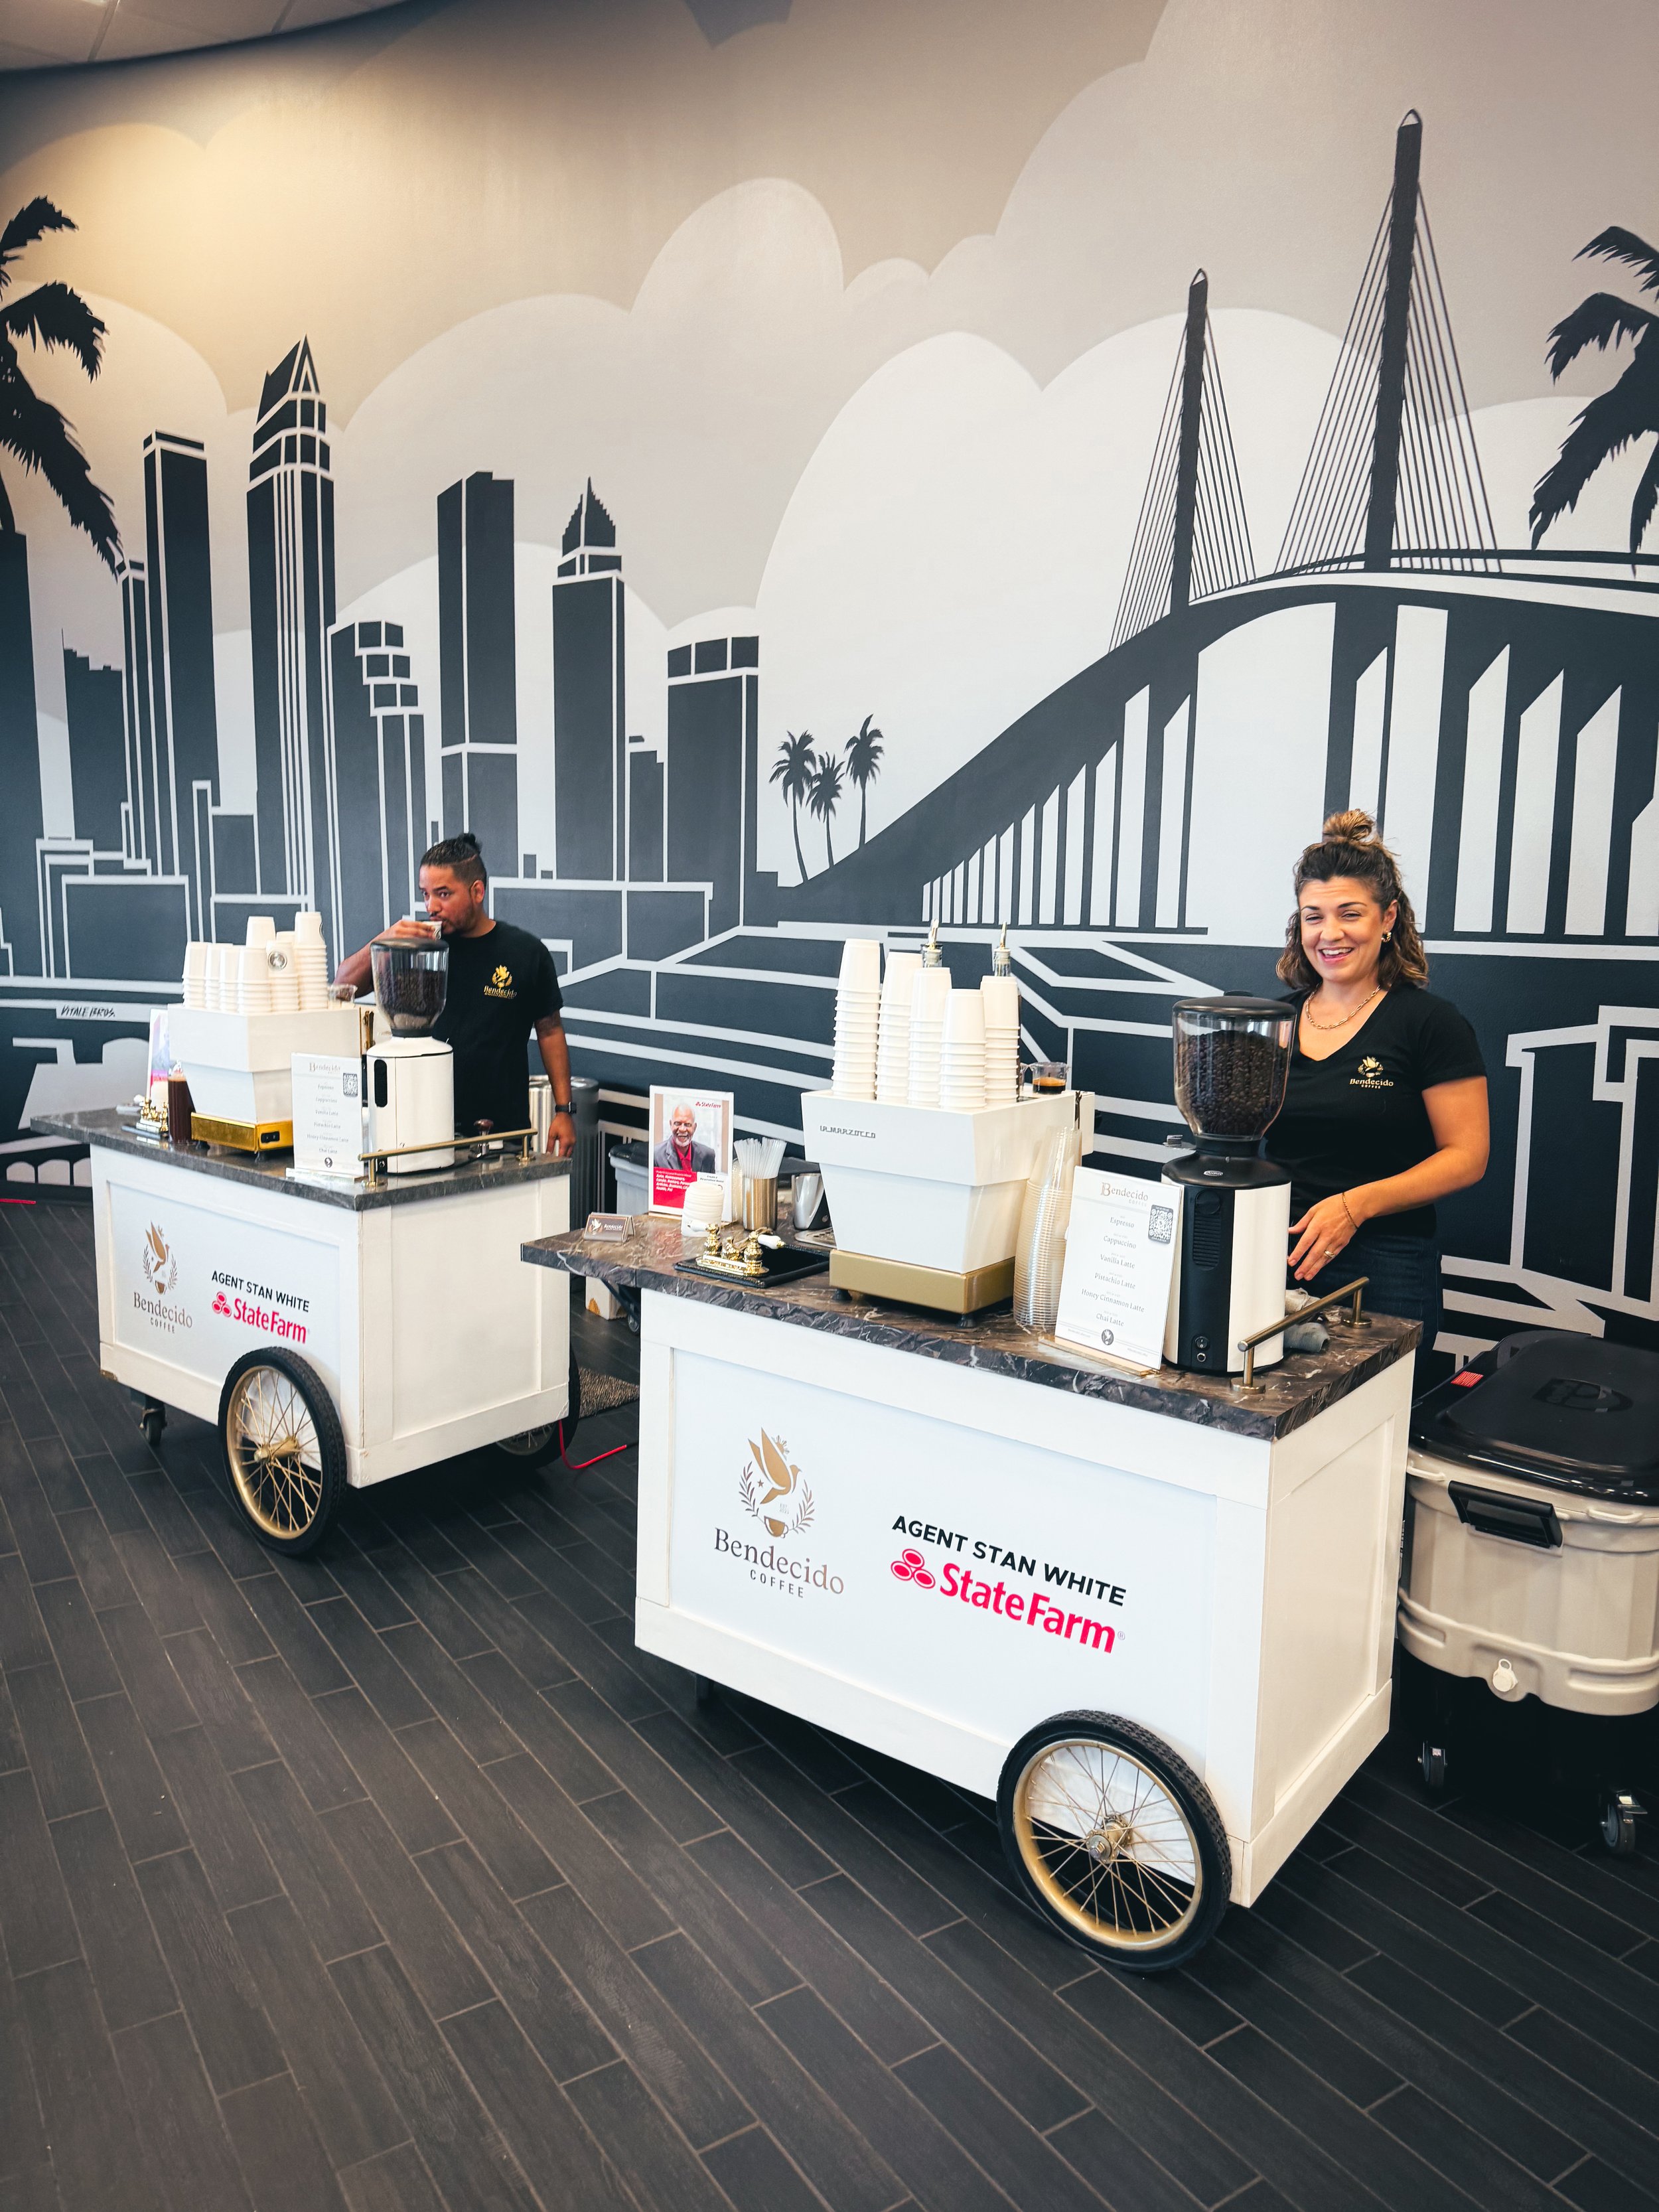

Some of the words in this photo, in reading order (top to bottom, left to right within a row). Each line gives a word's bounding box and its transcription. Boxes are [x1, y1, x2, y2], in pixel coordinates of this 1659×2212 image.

[1100, 1182, 1149, 1201] Bendecido
[1110, 1217, 1134, 1228] Espresso
[1104, 1235, 1136, 1248] Cappuccino
[1100, 1254, 1119, 1264] Vanilla
[1121, 1259, 1135, 1269] Latte
[1095, 1272, 1120, 1285] Pistachio
[1121, 1280, 1135, 1290] Latte
[212, 1270, 244, 1290] AGENT
[246, 1282, 273, 1300] STAN
[276, 1290, 310, 1313] WHITE
[1082, 1288, 1100, 1301] Honey
[1100, 1294, 1129, 1308] Cinnamon
[1130, 1303, 1145, 1313] Latte
[133, 1291, 193, 1328] Bendecido
[150, 1316, 175, 1334] COFFEE
[1096, 1313, 1109, 1321] Chai
[1110, 1317, 1124, 1327] Latte
[714, 1528, 844, 1595] Bendecido
[891, 1515, 968, 1552] AGENT
[972, 1540, 1037, 1576] STAN
[1044, 1563, 1127, 1607] WHITE
[749, 1569, 805, 1599] COFFEE
